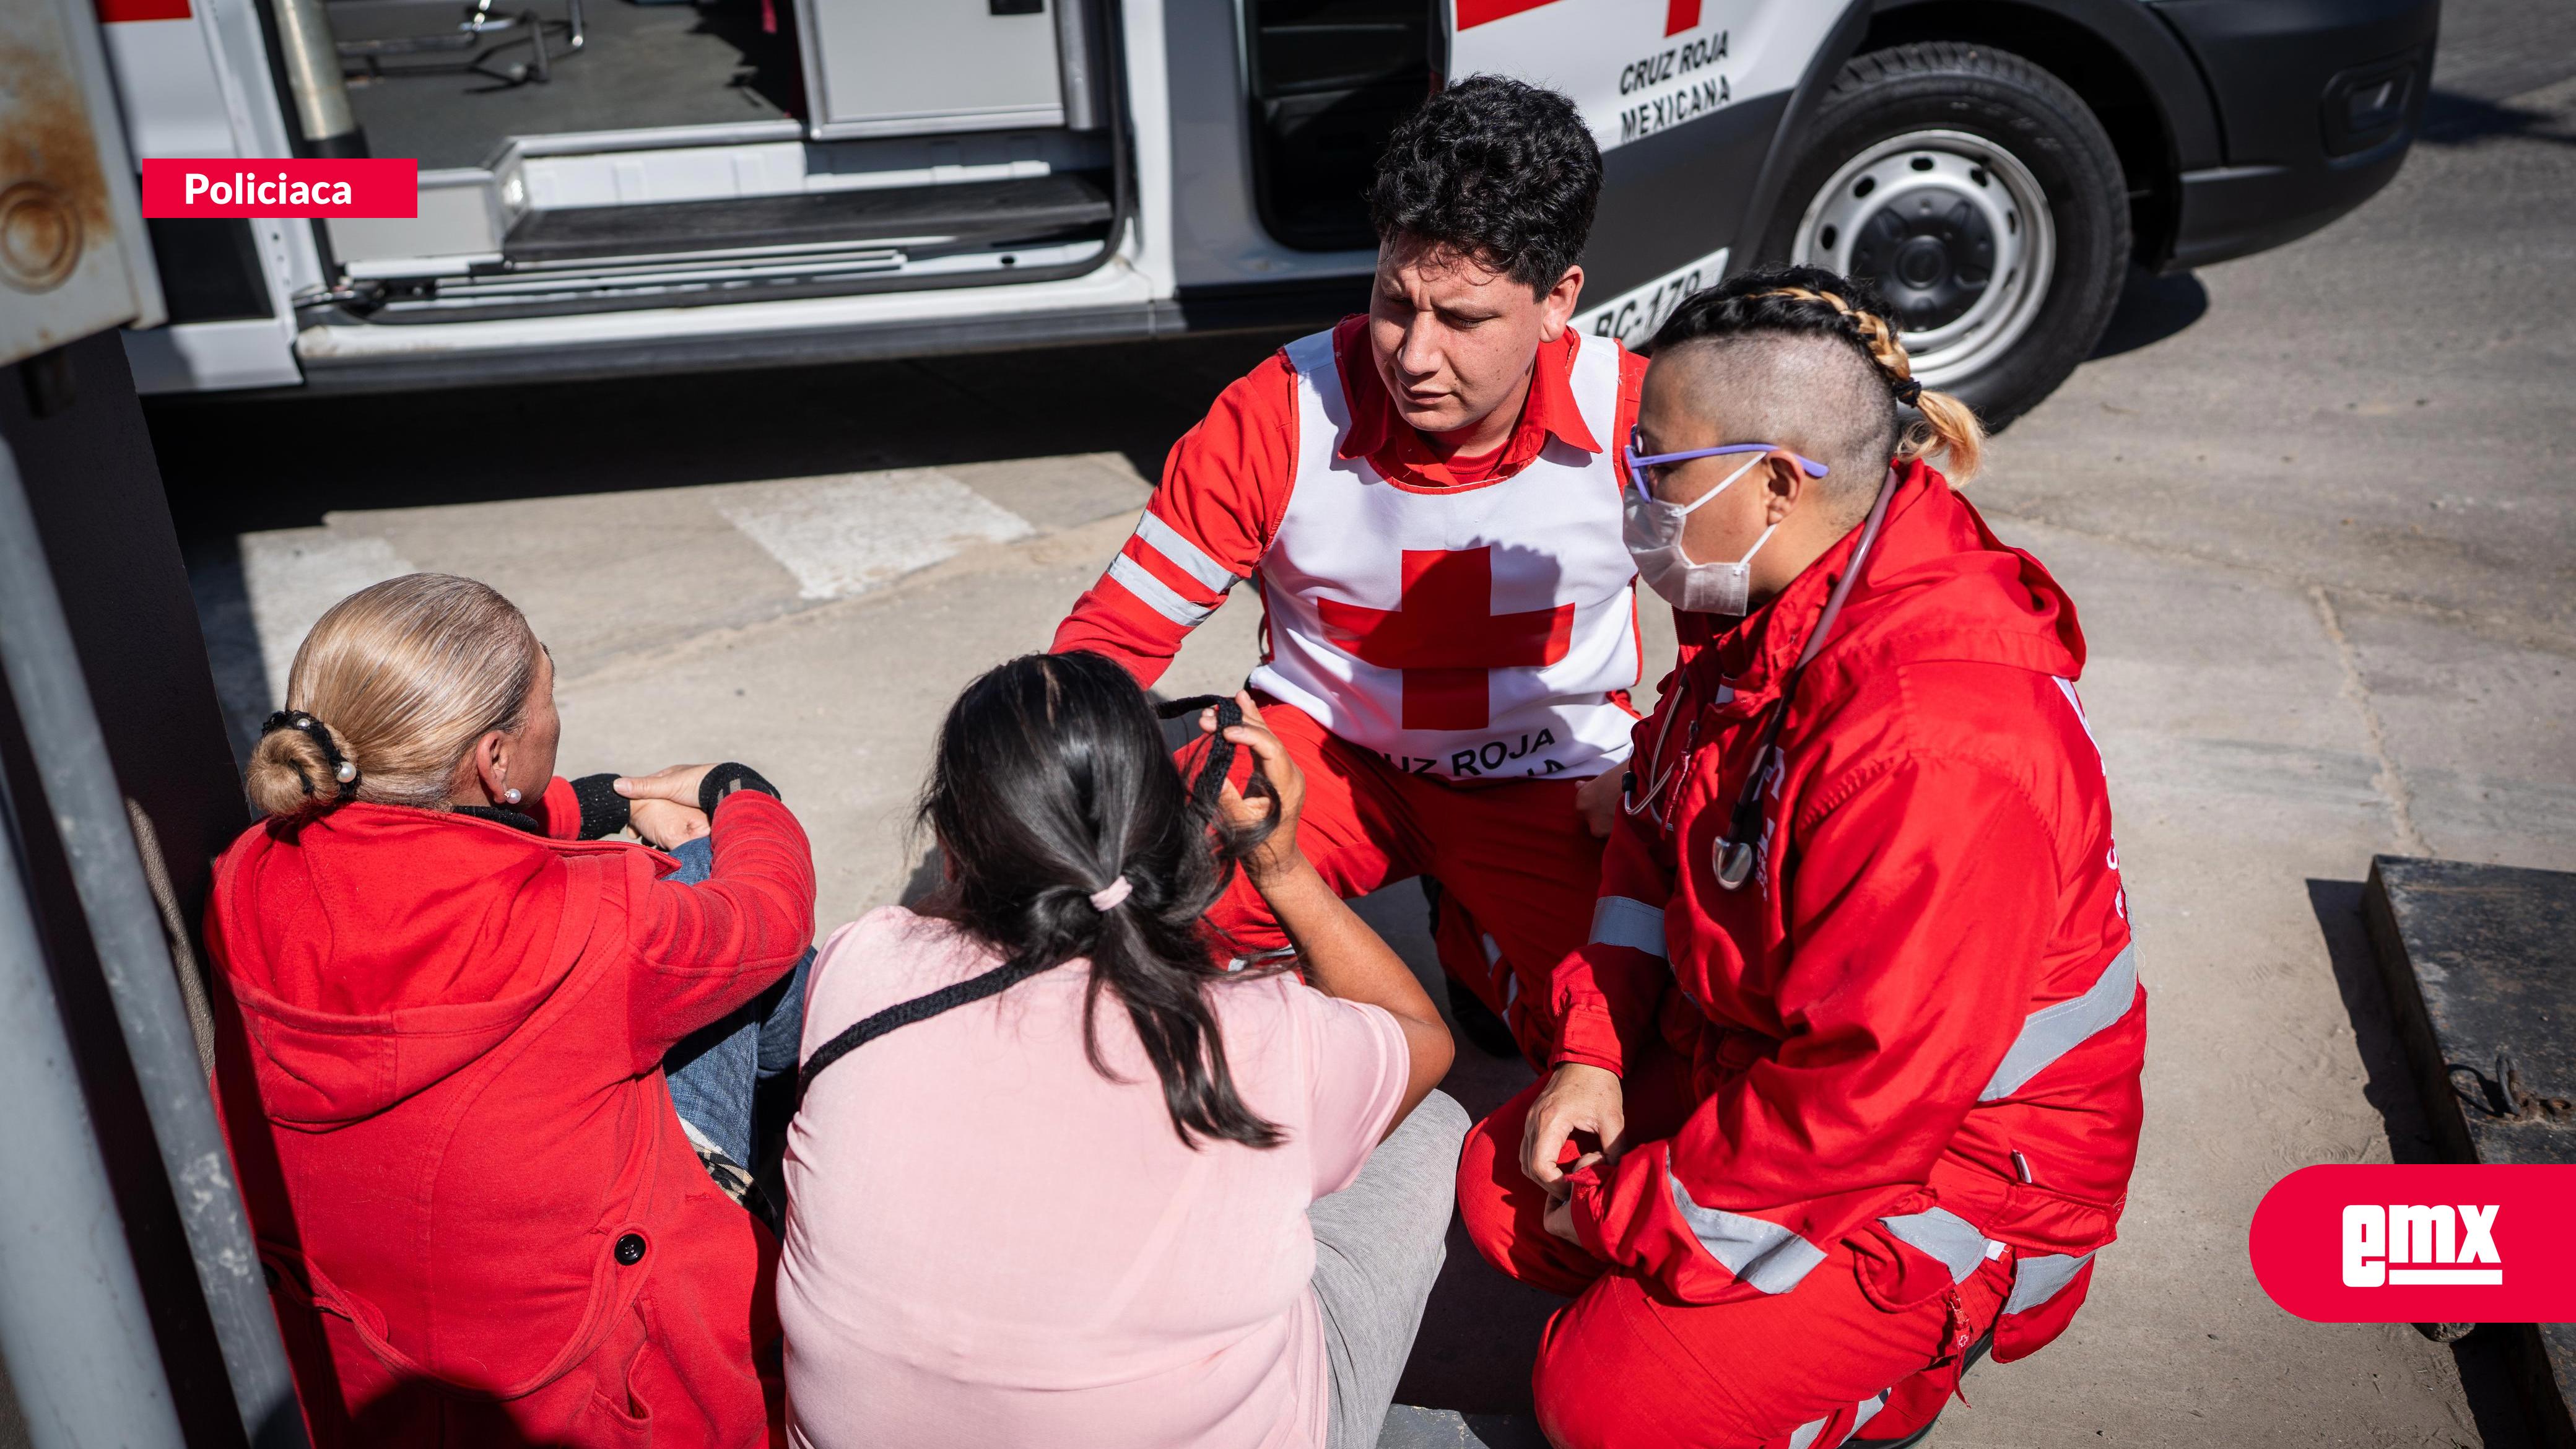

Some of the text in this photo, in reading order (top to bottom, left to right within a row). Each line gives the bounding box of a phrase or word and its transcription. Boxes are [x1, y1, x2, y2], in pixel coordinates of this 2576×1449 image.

[1619, 30, 1728, 95] CRUZ ROJA
[1620, 74, 1730, 143] MEXICANA
[1451, 728, 1555, 777] ROJA
